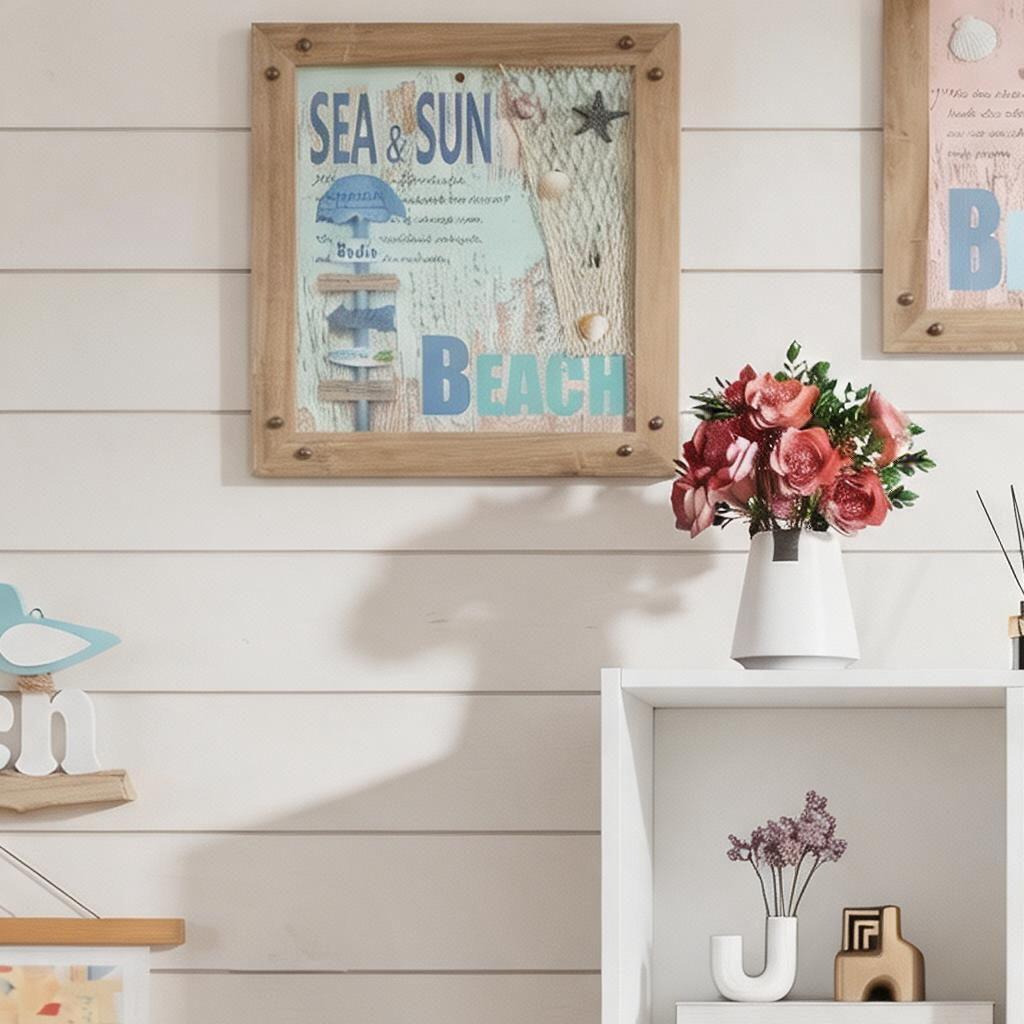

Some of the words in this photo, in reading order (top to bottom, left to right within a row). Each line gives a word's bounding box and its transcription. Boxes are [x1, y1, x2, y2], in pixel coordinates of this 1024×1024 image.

[310, 91, 377, 164] SEA
[386, 125, 404, 164] &
[416, 91, 491, 165] SUN
[421, 335, 626, 417] BEACH
